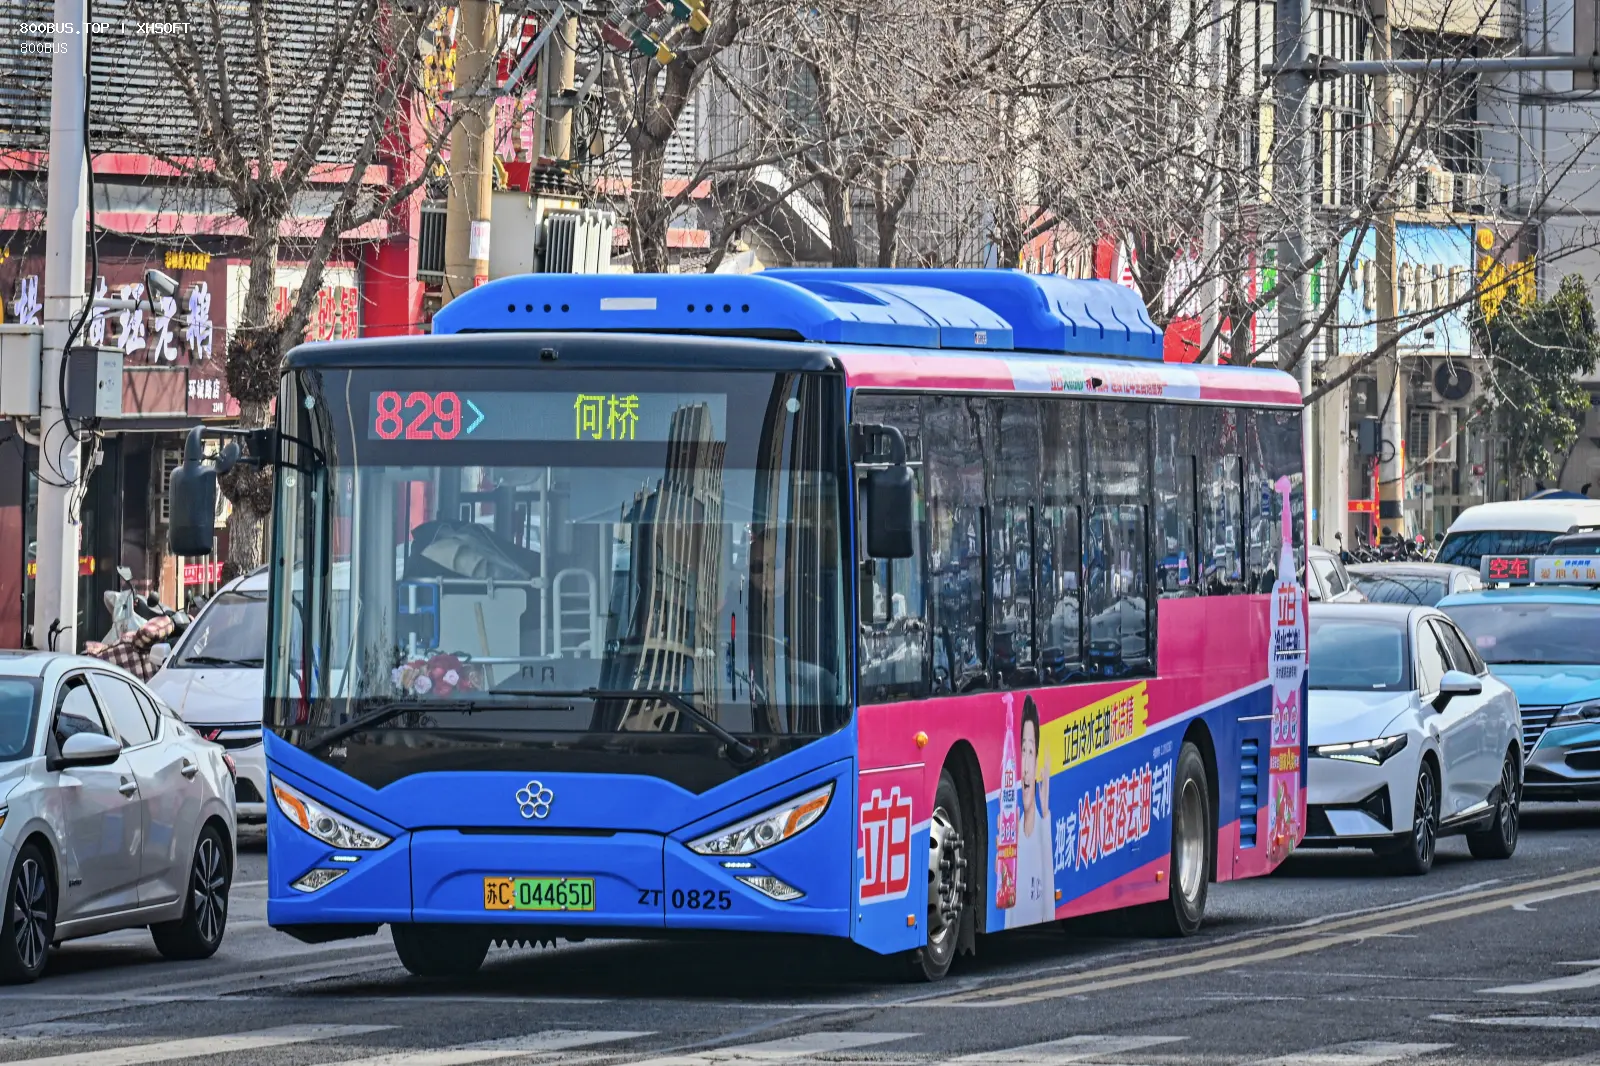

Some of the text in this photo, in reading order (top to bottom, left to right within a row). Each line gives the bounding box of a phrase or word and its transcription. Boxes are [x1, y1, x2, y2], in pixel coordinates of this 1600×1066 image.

[375, 391, 461, 440] 829
[573, 393, 640, 440] 何桥
[1489, 557, 1529, 579] 空车
[1277, 582, 1297, 627] 立白
[1062, 694, 1135, 767] 立白冷水去油洗洁精
[637, 888, 733, 910] ZT 0825
